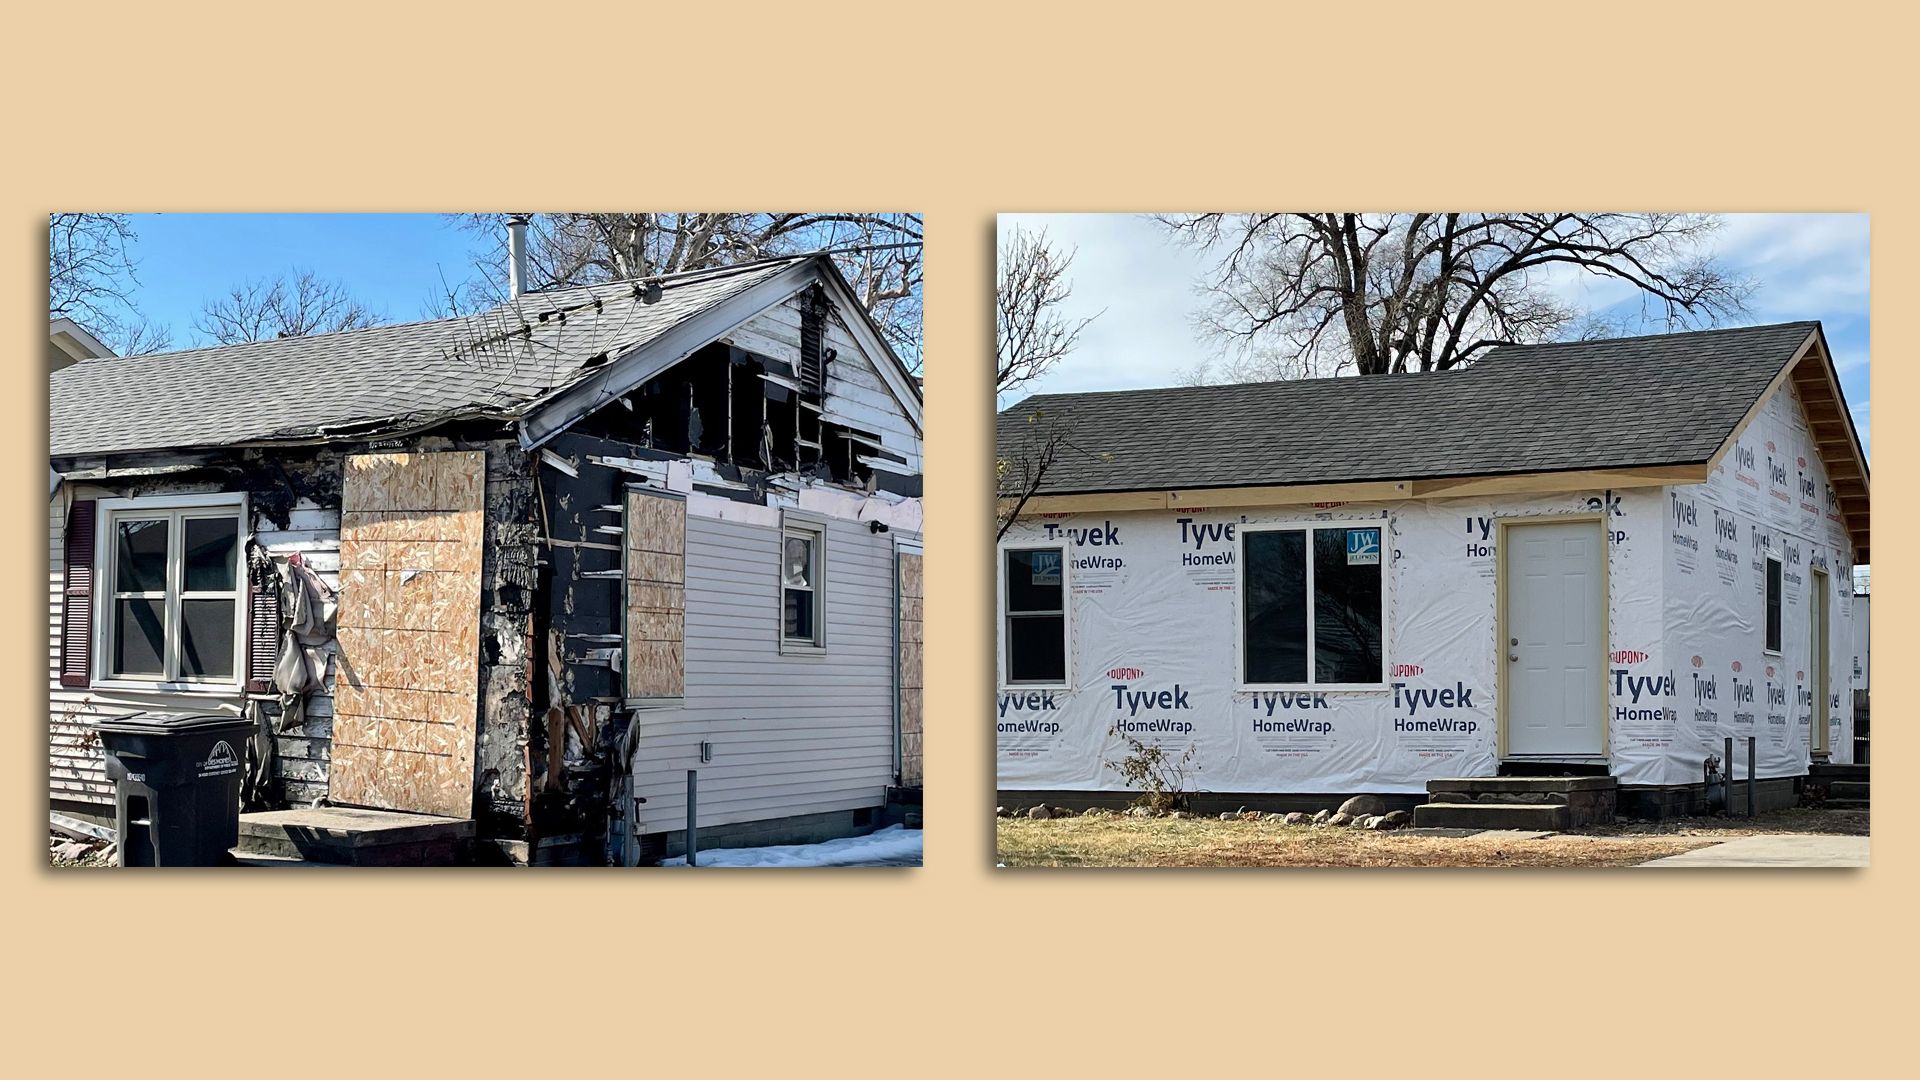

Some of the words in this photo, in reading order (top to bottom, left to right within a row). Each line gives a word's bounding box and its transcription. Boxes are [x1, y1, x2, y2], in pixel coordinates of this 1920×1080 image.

[1735, 439, 1756, 472] Tyvek
[1670, 491, 1698, 529] Tyvek
[1176, 515, 1246, 550] Tyve
[1713, 509, 1738, 543] Tyvek
[1350, 532, 1376, 552] JW
[1033, 554, 1058, 573] JW
[1070, 555, 1123, 571] meWrap
[1182, 551, 1236, 567] HomeW
[1110, 667, 1141, 680] DUPONT
[1610, 669, 1676, 704] Tyvek
[1111, 684, 1190, 717] Tyvek
[1391, 681, 1473, 716] Tyvek
[1692, 672, 1718, 706] Tyvek
[1732, 677, 1754, 709] Tyvek
[1766, 681, 1786, 711] Tyvek
[1797, 684, 1811, 711] Tyve
[997, 689, 1057, 718] yvek
[1616, 706, 1677, 724] HomeWrap
[997, 719, 1060, 735] omeWrap
[1116, 718, 1193, 735] HomeWrap
[1253, 718, 1332, 735] HomeWrap
[1394, 718, 1477, 735] HomeWrap
